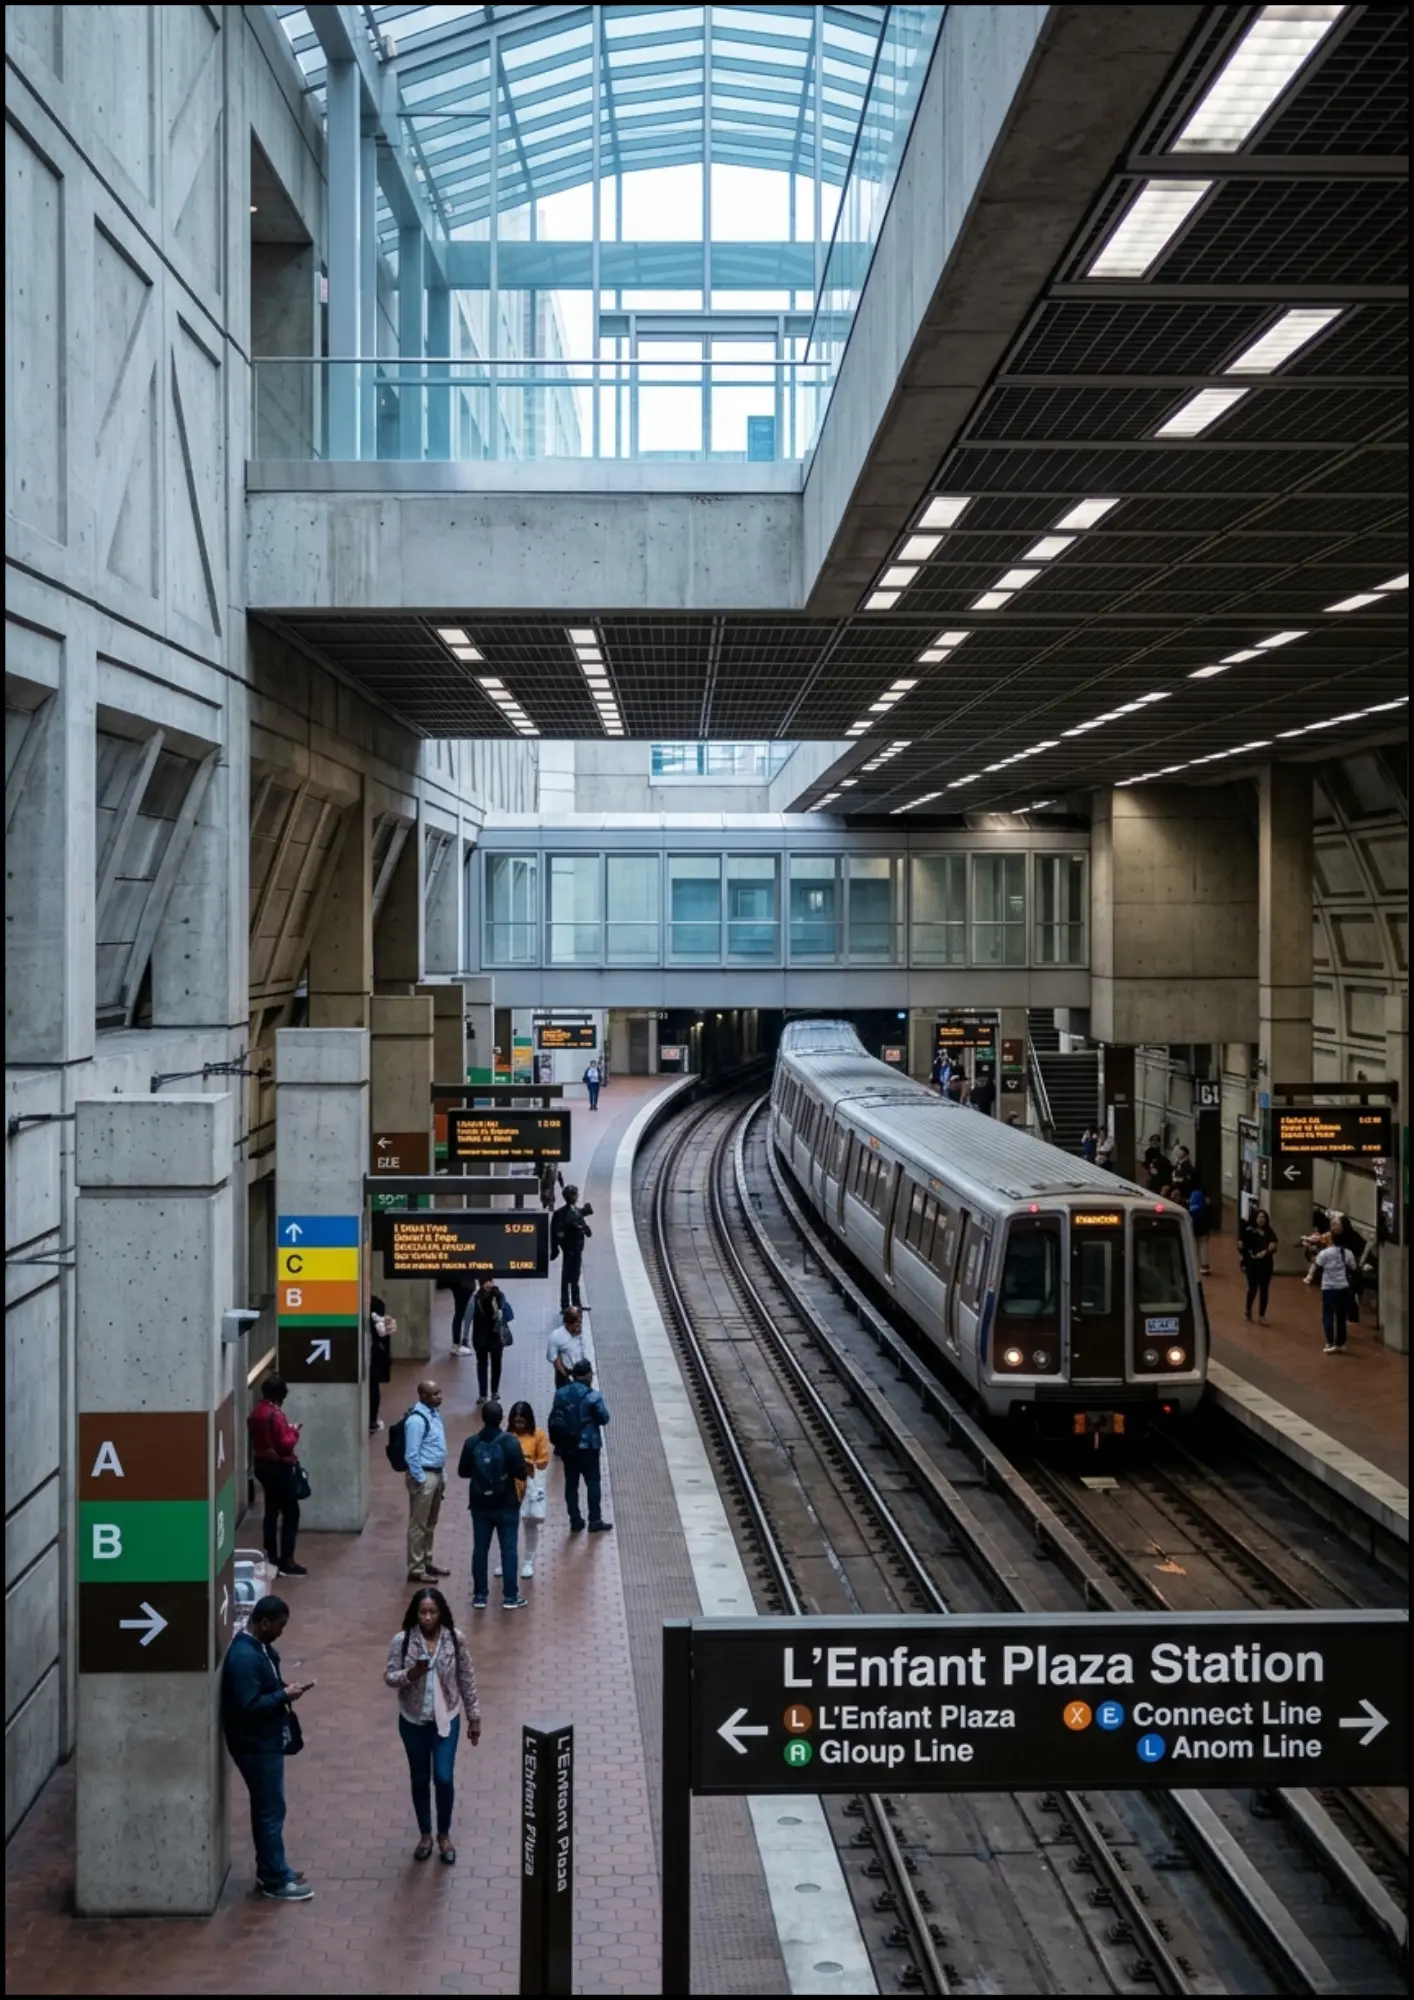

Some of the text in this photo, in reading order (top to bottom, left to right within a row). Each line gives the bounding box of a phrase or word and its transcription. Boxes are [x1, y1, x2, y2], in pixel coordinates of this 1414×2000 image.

[286, 1254, 303, 1274] C
[286, 1287, 302, 1307] B
[91, 1441, 125, 1477] A
[92, 1523, 123, 1559] B
[784, 1642, 1323, 1688] L'Enfant Plaza Station
[791, 1705, 1016, 1730] L L'Enfant Plaza
[1070, 1701, 1322, 1726] X E Connect Line
[914, 1738, 974, 1762] Line
[1144, 1734, 1322, 1759] L Anom Line
